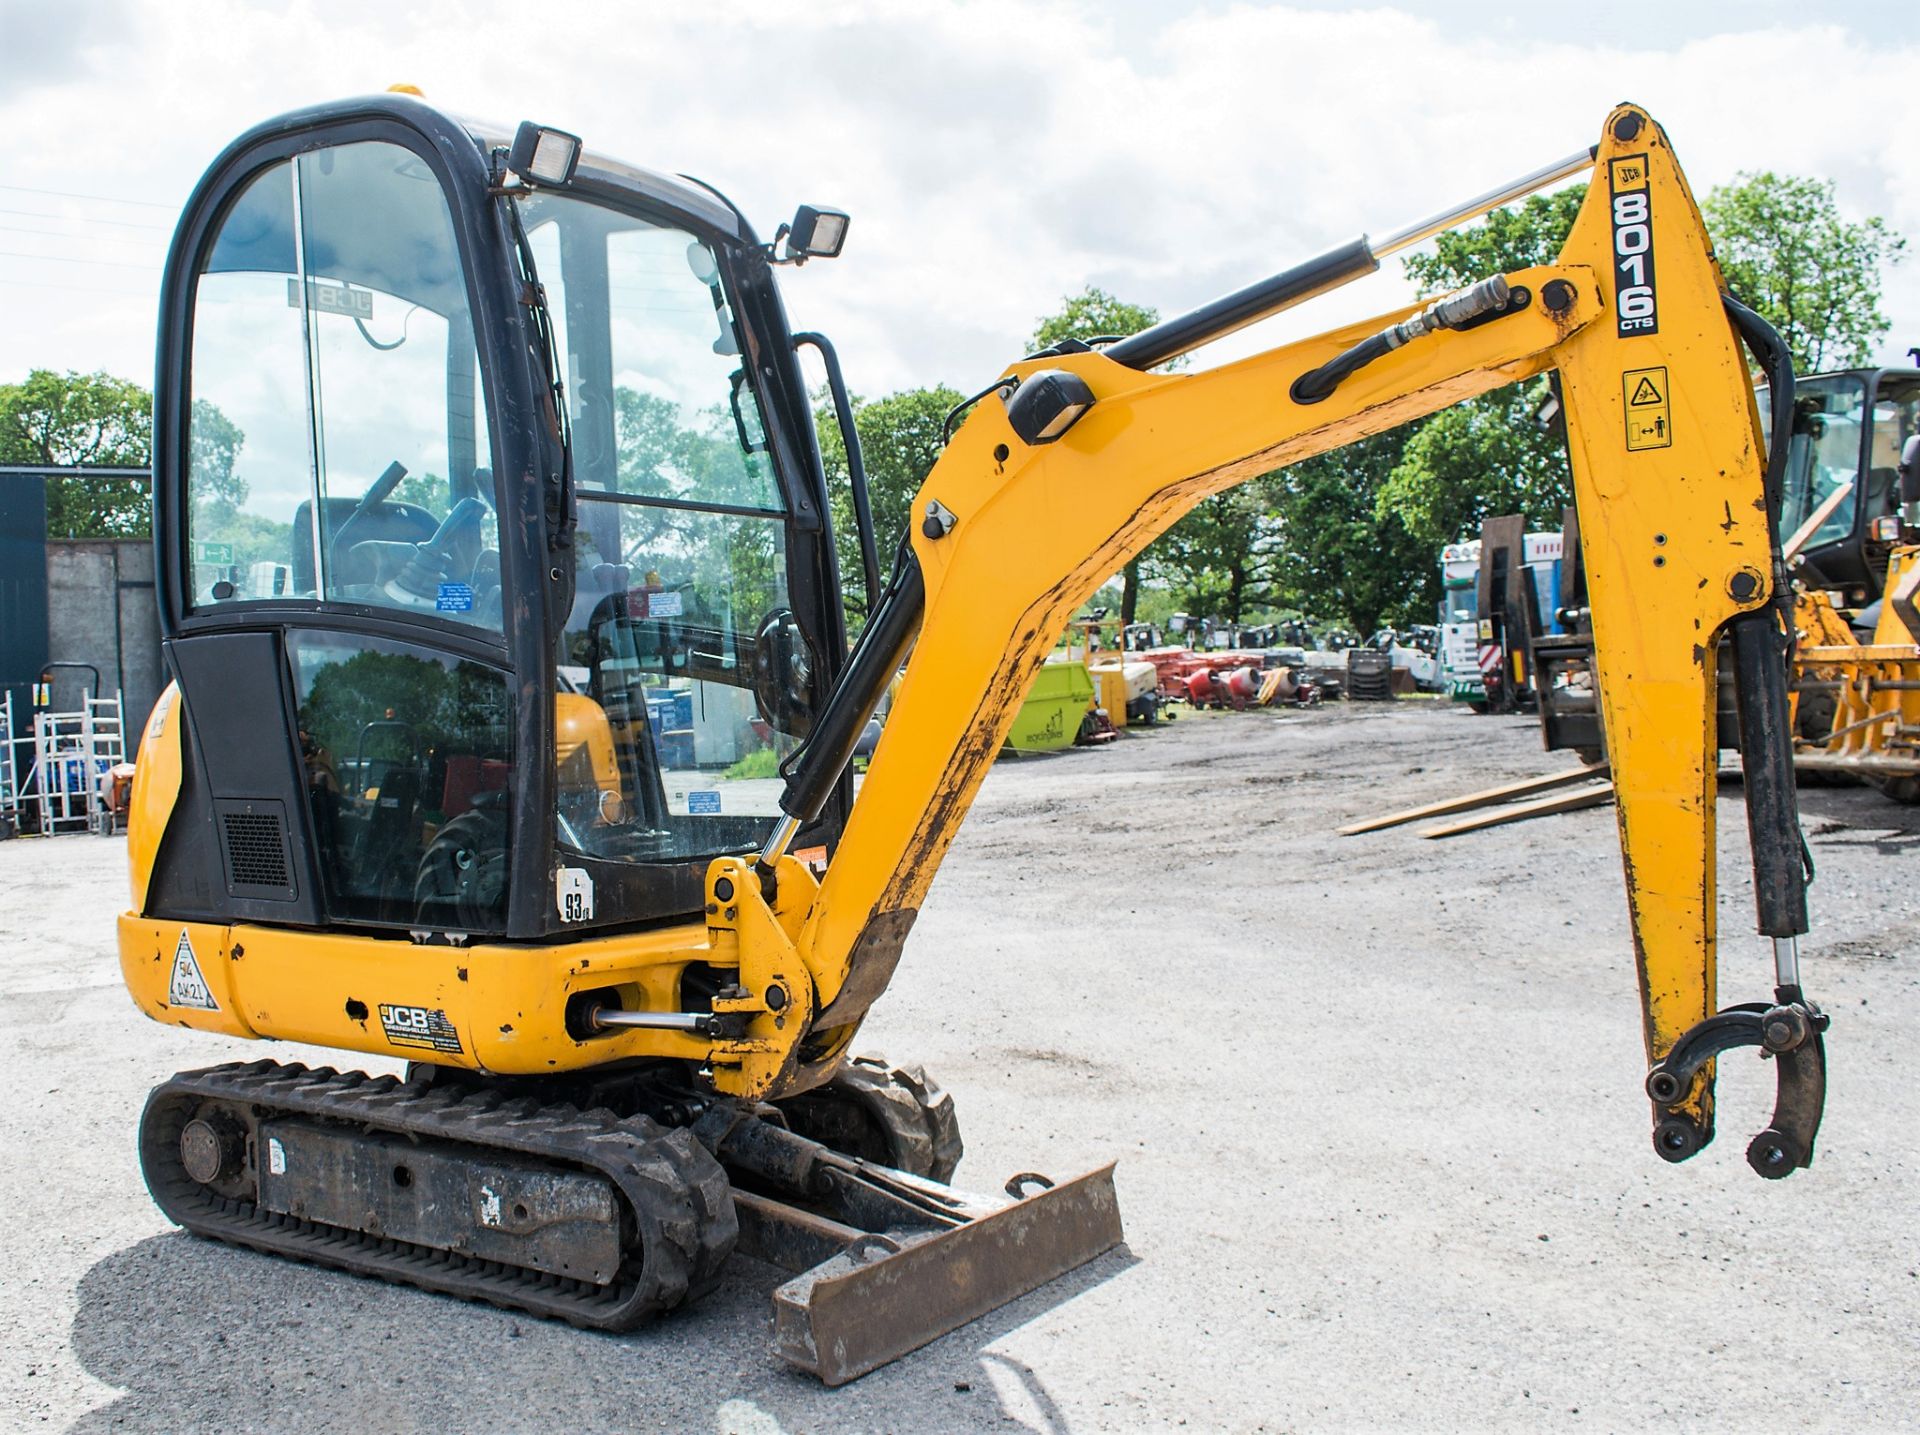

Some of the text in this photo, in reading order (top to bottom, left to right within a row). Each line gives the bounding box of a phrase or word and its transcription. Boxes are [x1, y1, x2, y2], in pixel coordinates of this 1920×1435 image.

[1621, 167, 1641, 183] JCB
[1614, 193, 1654, 319] 8016
[1620, 317, 1654, 330] CTS
[382, 1006, 428, 1028] JCB
